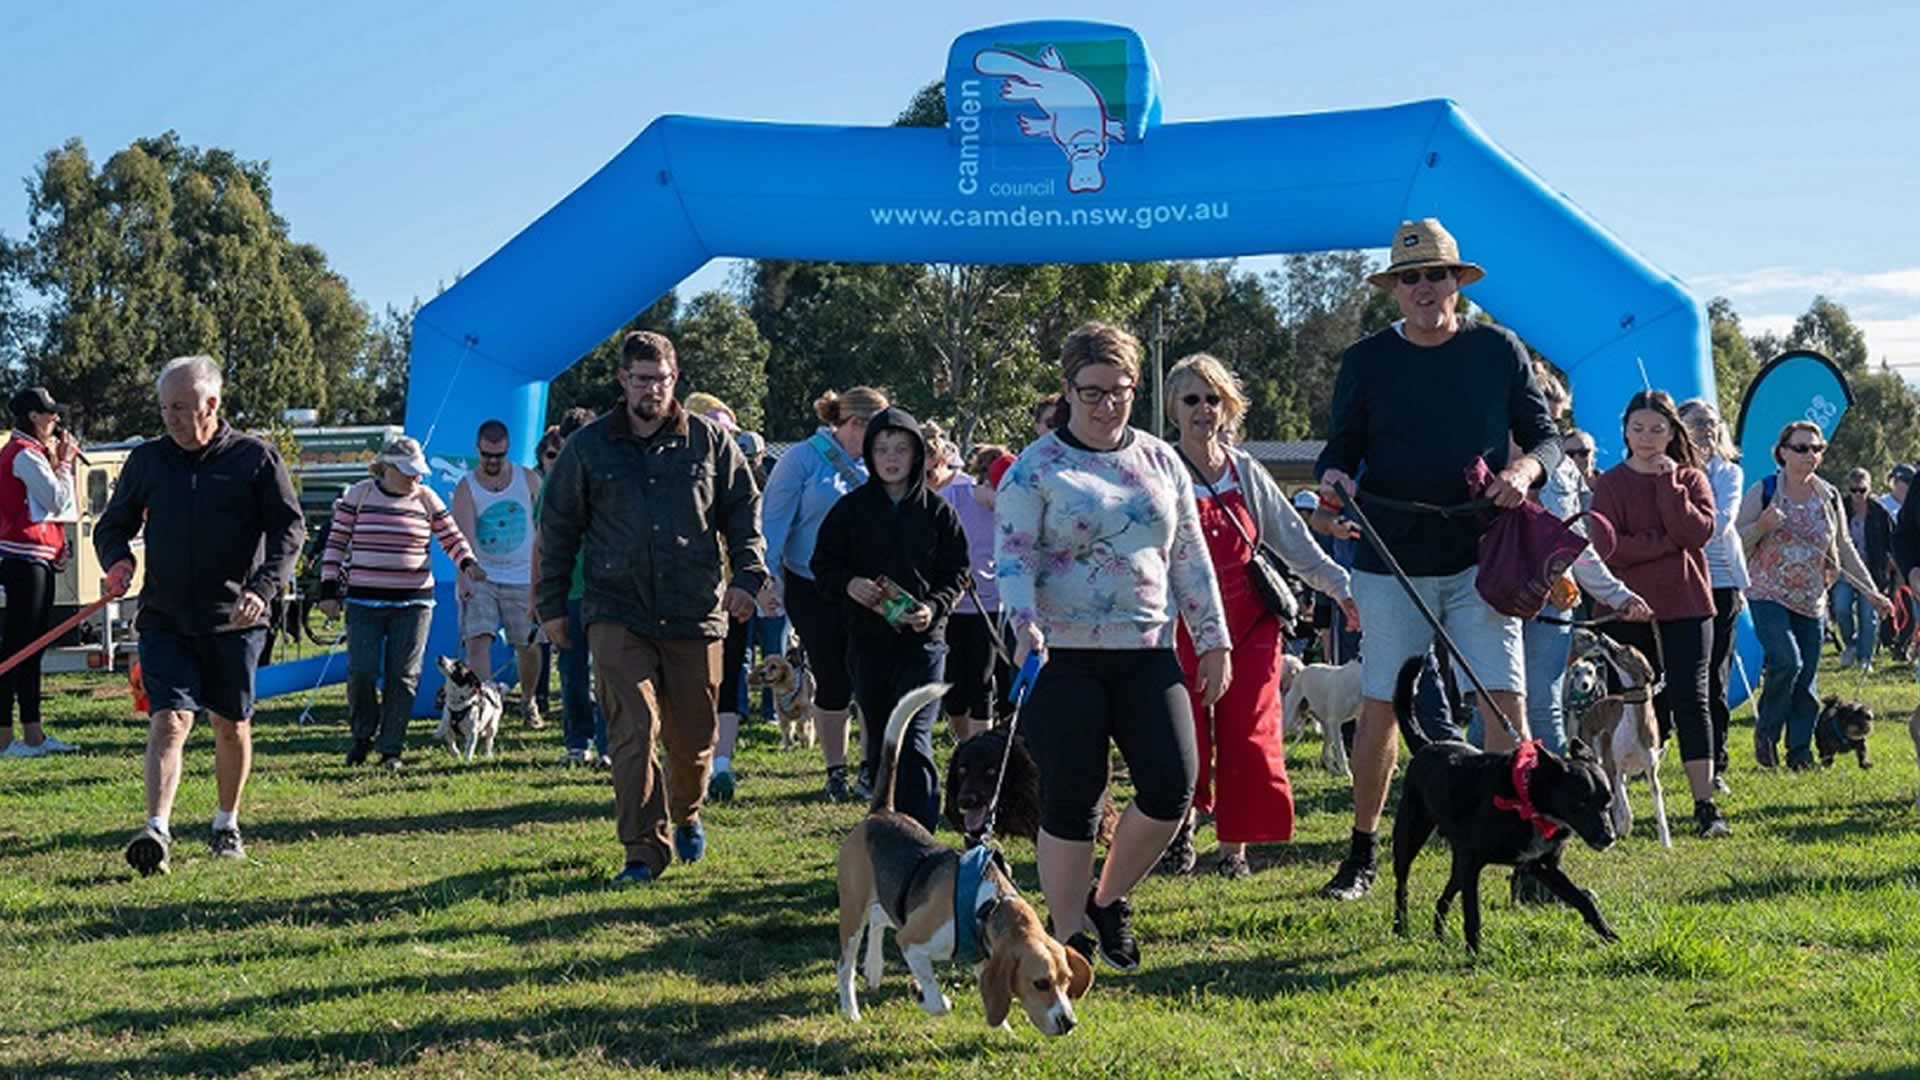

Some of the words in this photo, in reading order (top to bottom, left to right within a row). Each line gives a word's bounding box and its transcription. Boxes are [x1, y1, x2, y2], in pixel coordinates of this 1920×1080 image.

[957, 79, 981, 195] camden
[989, 179, 1055, 197] council
[870, 202, 1229, 229] www.camden.nsw.gov.au
